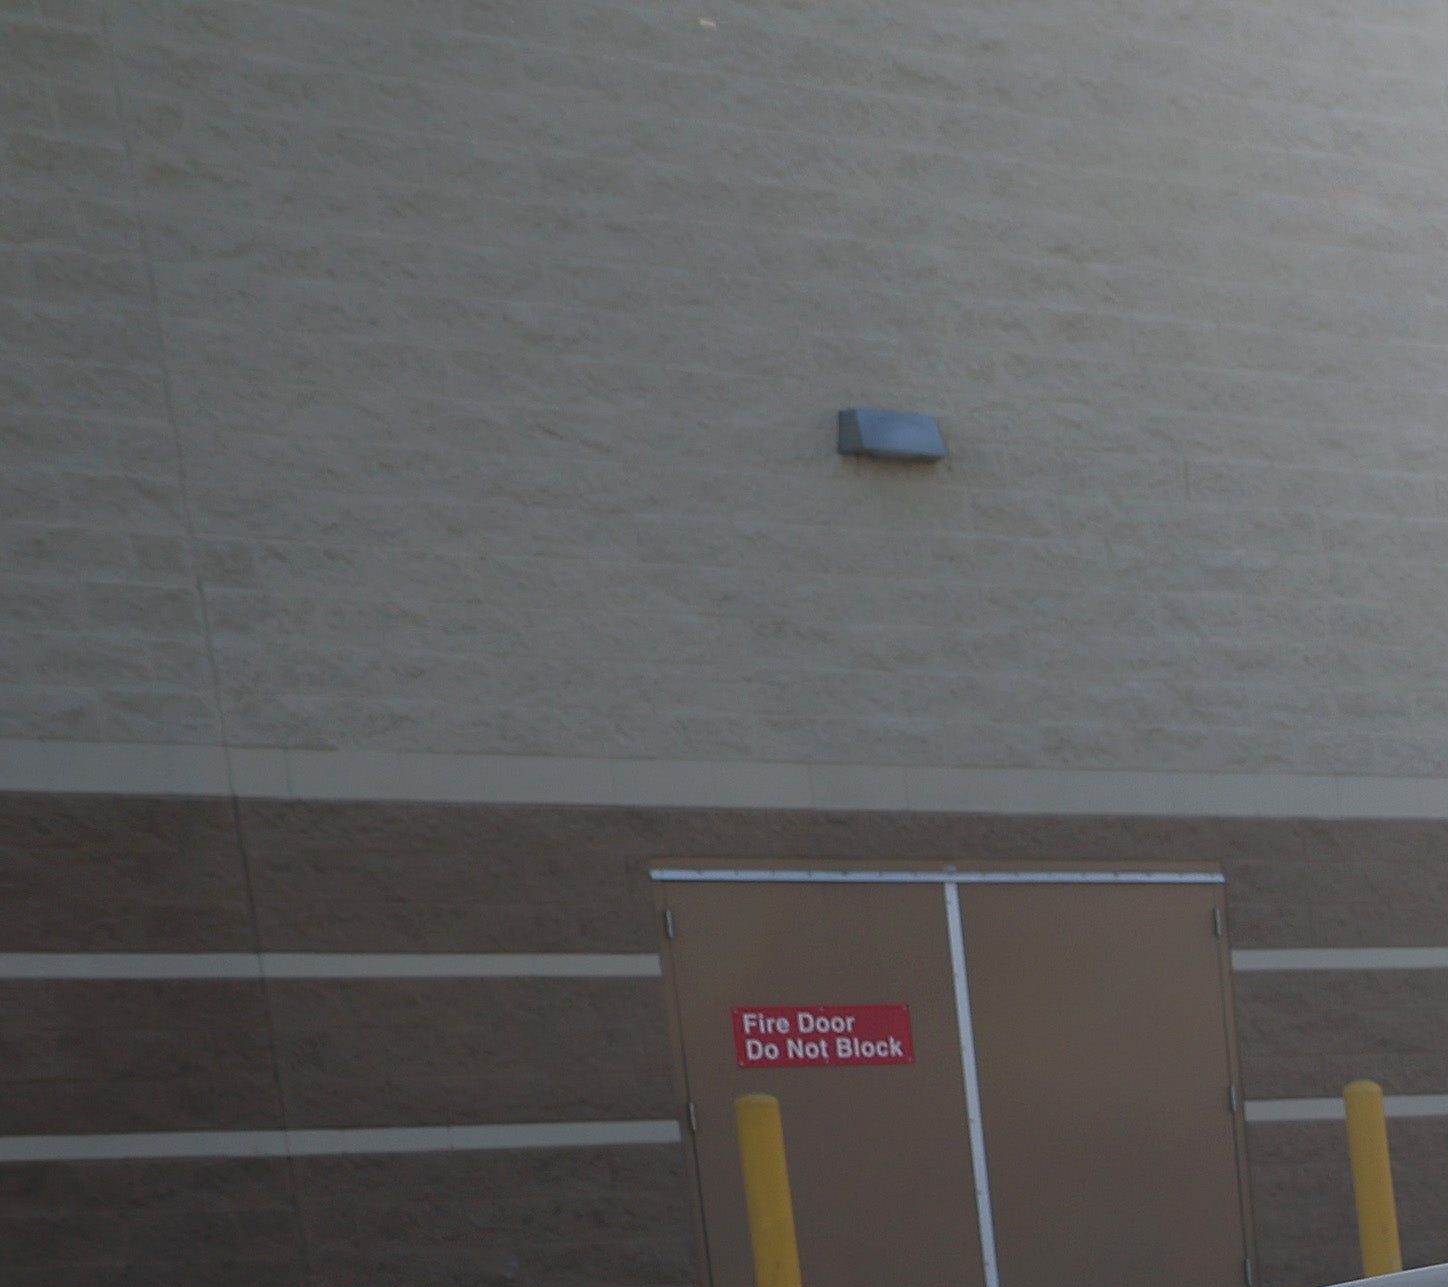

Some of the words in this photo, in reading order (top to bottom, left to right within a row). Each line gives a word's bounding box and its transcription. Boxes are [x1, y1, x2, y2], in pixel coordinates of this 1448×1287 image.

[742, 1012, 790, 1035] Fire
[797, 1011, 856, 1034] Door
[745, 1039, 780, 1061] Do
[786, 1038, 830, 1059] Not
[835, 1035, 904, 1059] Block
